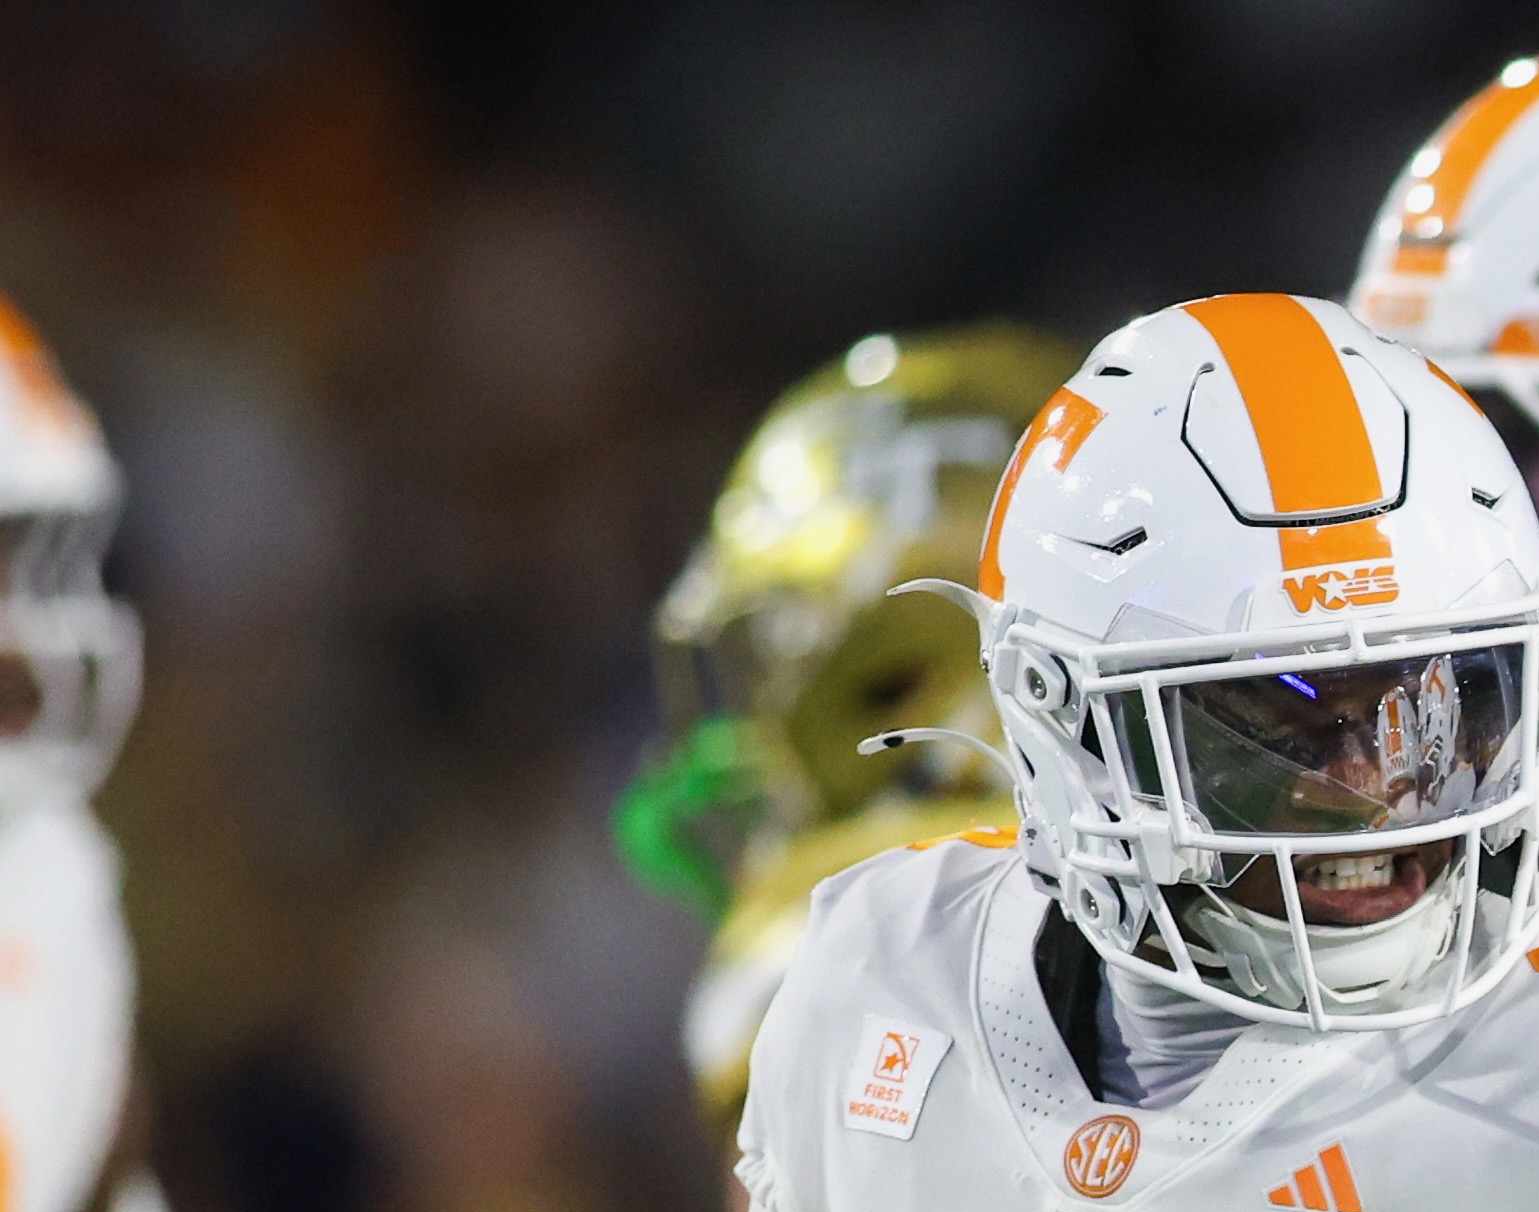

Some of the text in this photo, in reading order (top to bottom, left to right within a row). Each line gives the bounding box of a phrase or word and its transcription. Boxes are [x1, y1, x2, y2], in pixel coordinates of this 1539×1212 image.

[863, 1082, 904, 1104] FIRST
[848, 1101, 911, 1126] HORIZON
[1070, 1121, 1133, 1188] SEC
